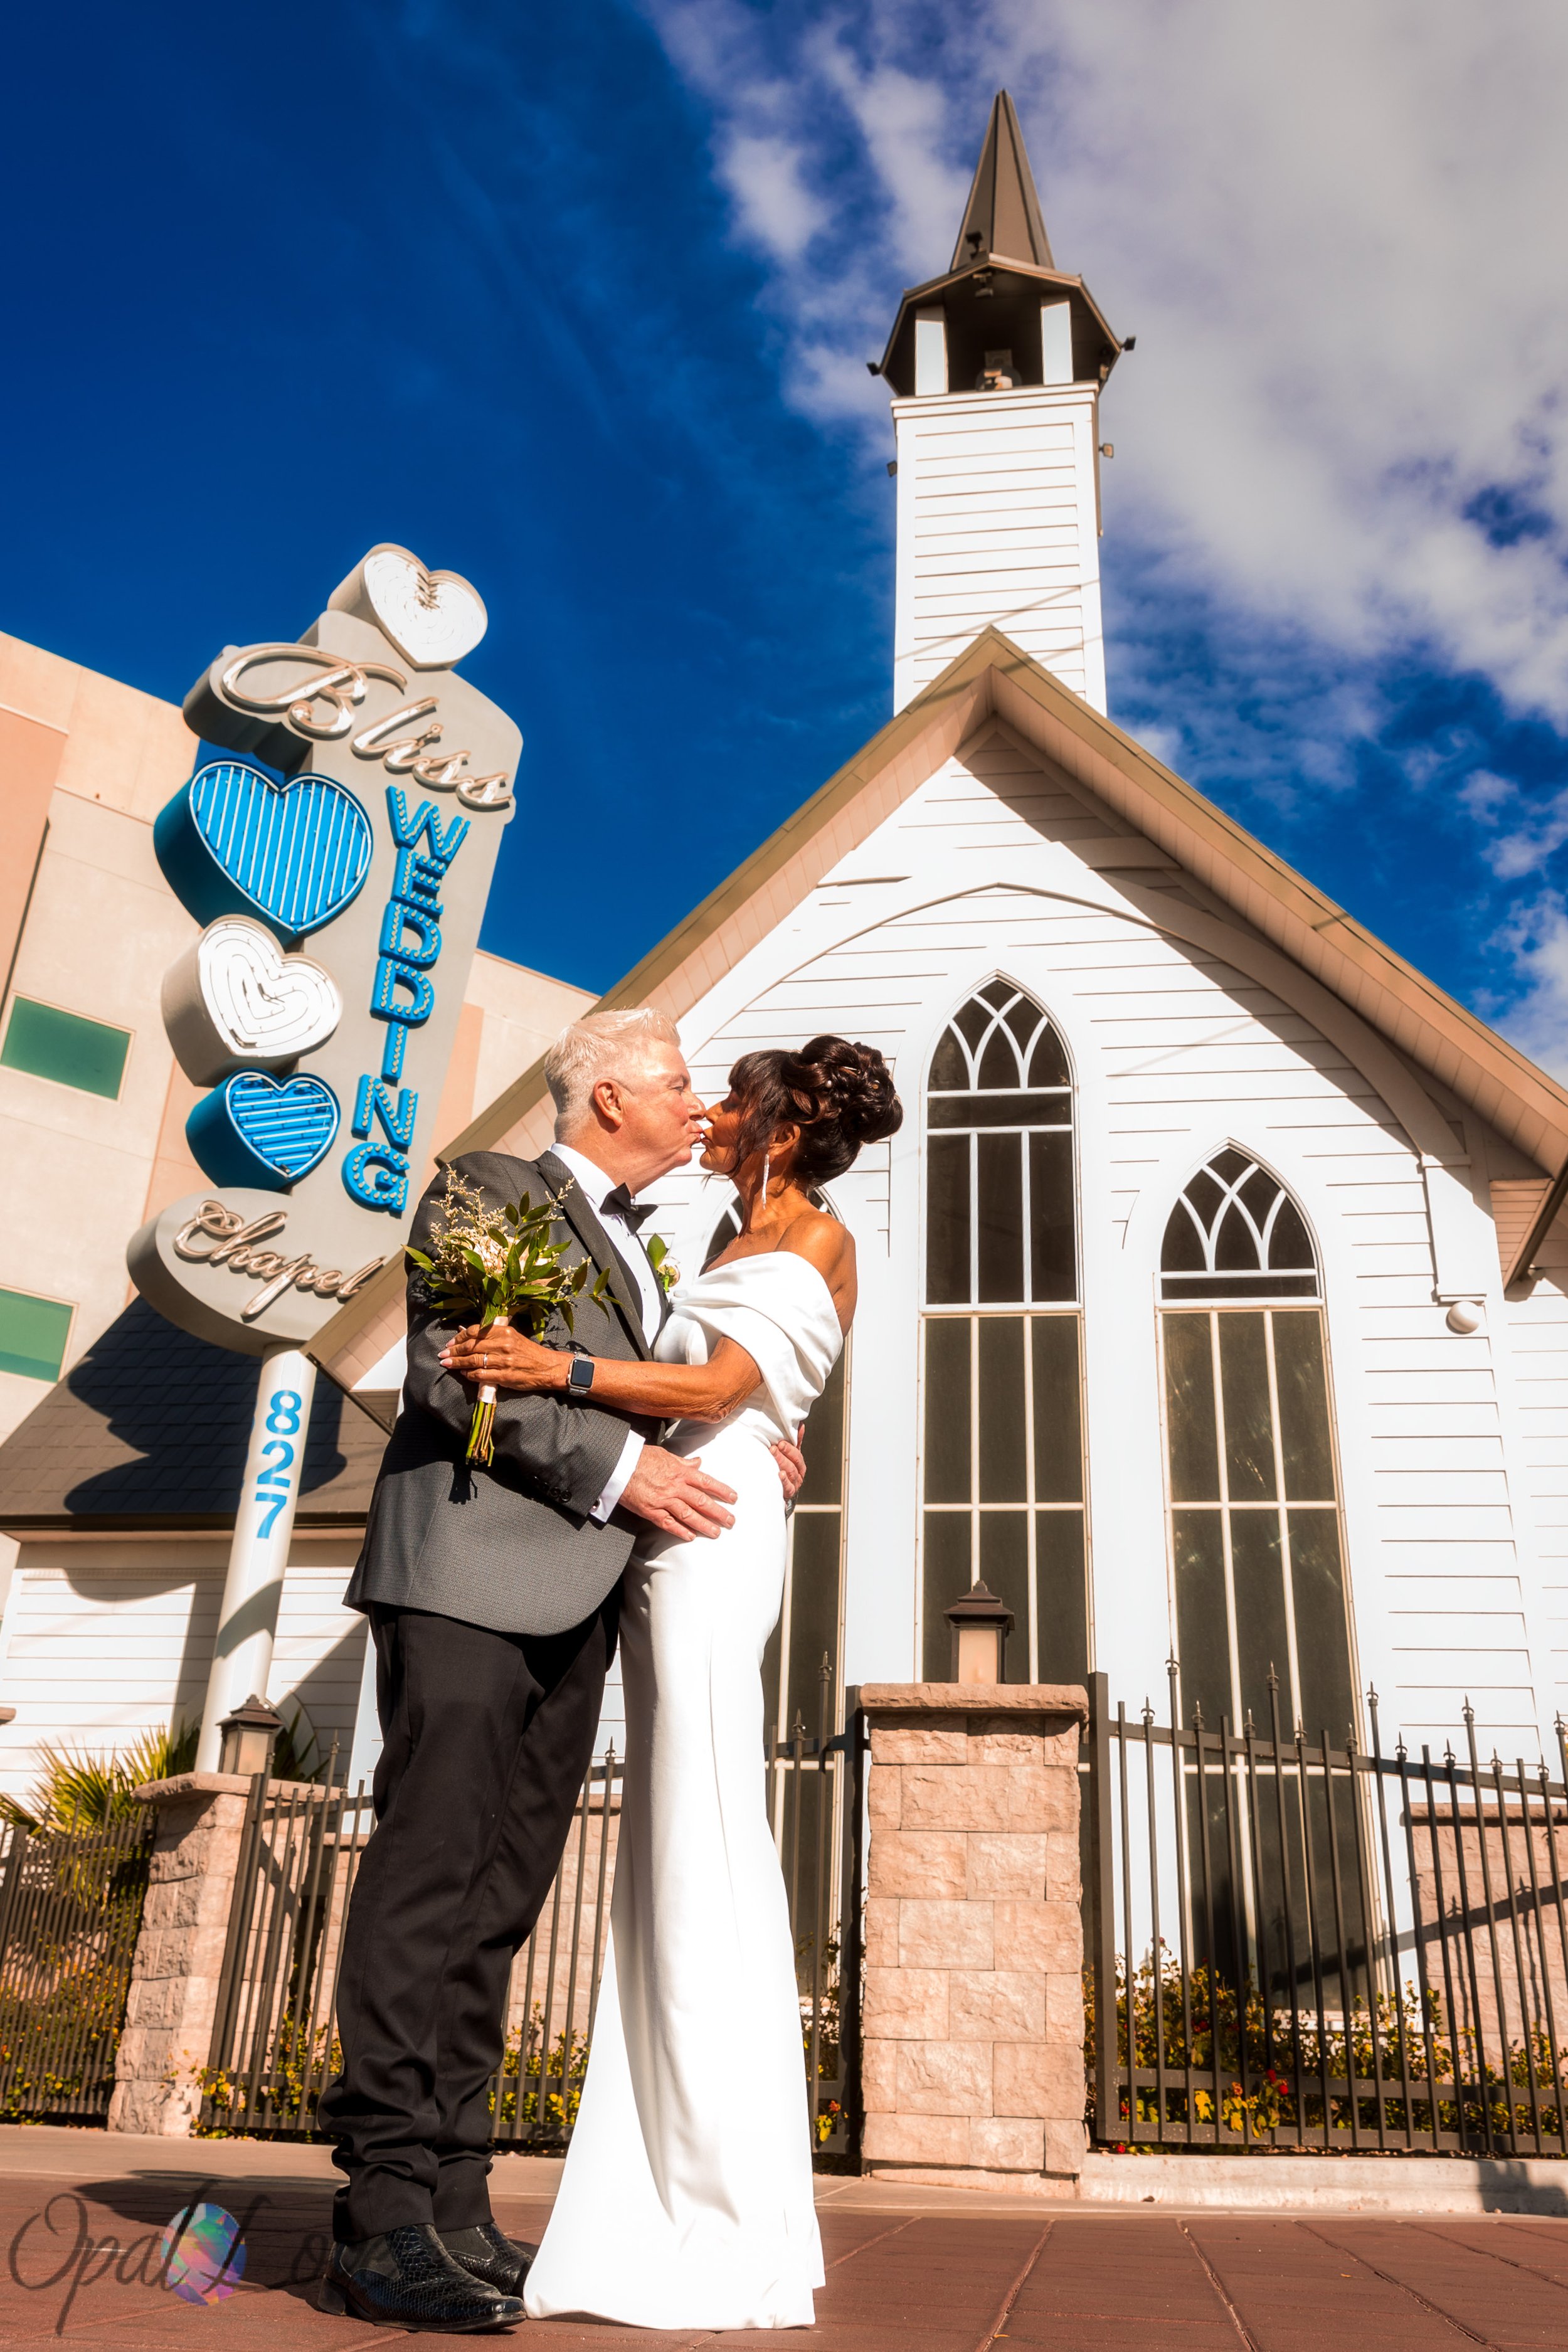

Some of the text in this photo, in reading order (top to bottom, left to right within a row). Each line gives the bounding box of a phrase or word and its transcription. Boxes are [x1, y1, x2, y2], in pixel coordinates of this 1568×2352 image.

[221, 646, 512, 808] Bliss
[342, 785, 470, 1211] WEDDING
[173, 1200, 386, 1317] Chapel
[255, 1389, 302, 1539] 827
